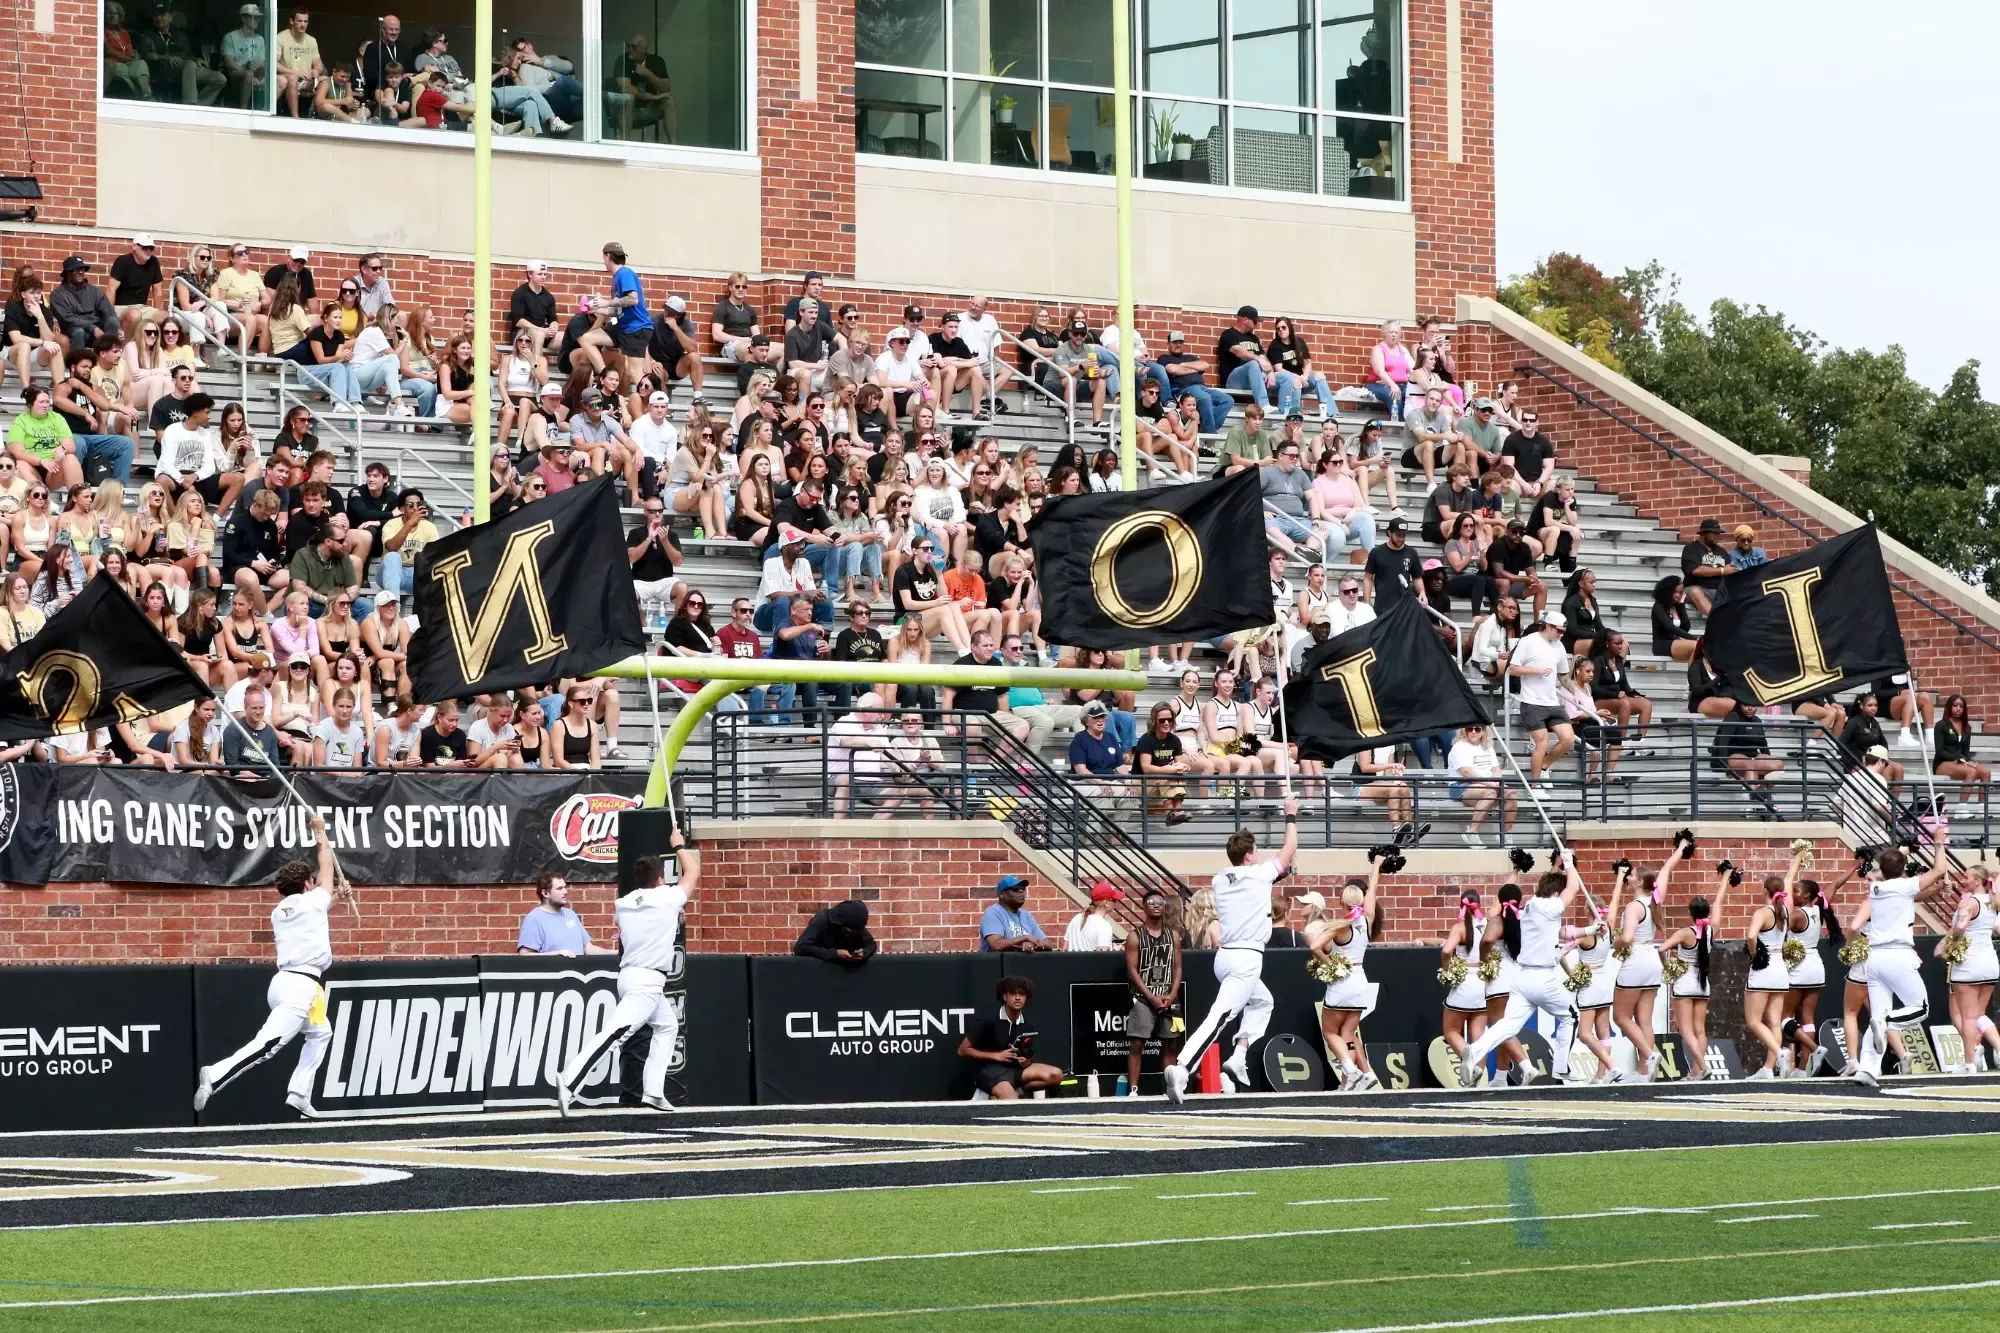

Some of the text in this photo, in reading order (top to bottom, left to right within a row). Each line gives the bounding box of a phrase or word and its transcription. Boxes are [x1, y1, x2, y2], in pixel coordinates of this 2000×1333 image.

[1090, 510, 1203, 629] O
[591, 798, 626, 810] Raising
[124, 800, 234, 849] CANE'S
[243, 804, 373, 850] STUDENT
[384, 804, 510, 848] SECTION
[785, 1008, 975, 1038] CLEMENT
[322, 989, 620, 1098] LINDENWOO
[829, 1039, 935, 1056] AUTO GROUP
[1096, 1040, 1106, 1048] The
[1911, 1025, 1937, 1072] ET ON
[1277, 1052, 1311, 1084] U
[1385, 1052, 1411, 1089] S
